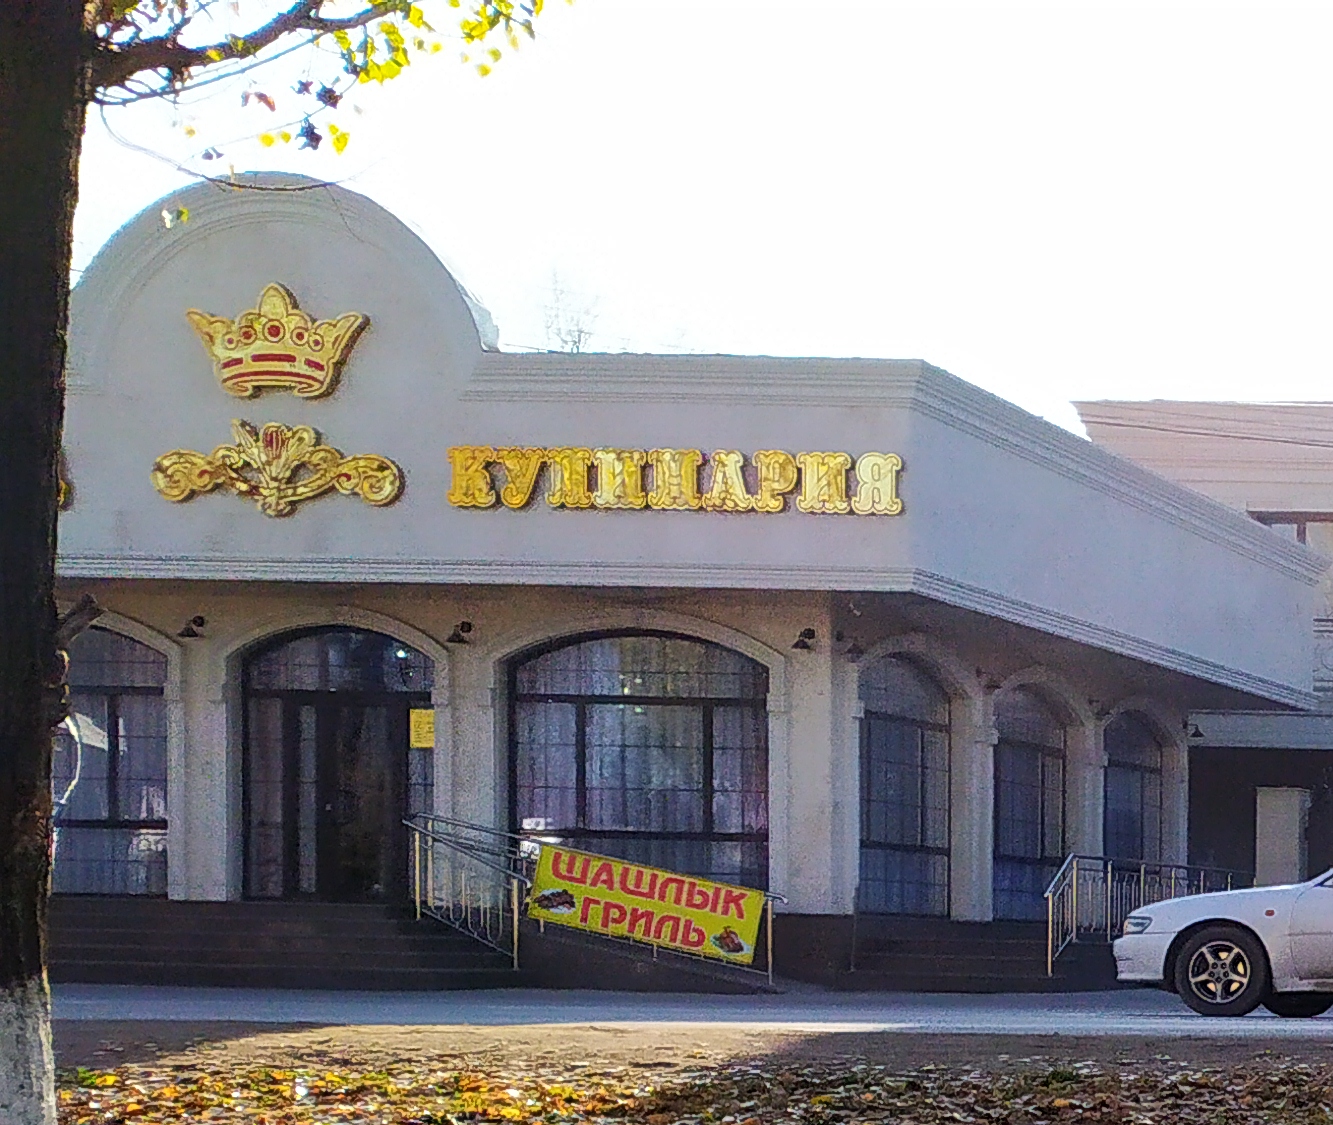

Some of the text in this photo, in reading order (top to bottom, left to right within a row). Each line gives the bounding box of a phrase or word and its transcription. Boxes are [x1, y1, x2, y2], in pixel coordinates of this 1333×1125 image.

[447, 445, 902, 515] КУЛИНАРИЯ
[551, 851, 748, 920] ШАШЛЫК
[579, 896, 707, 948] ГРИЛЬ
